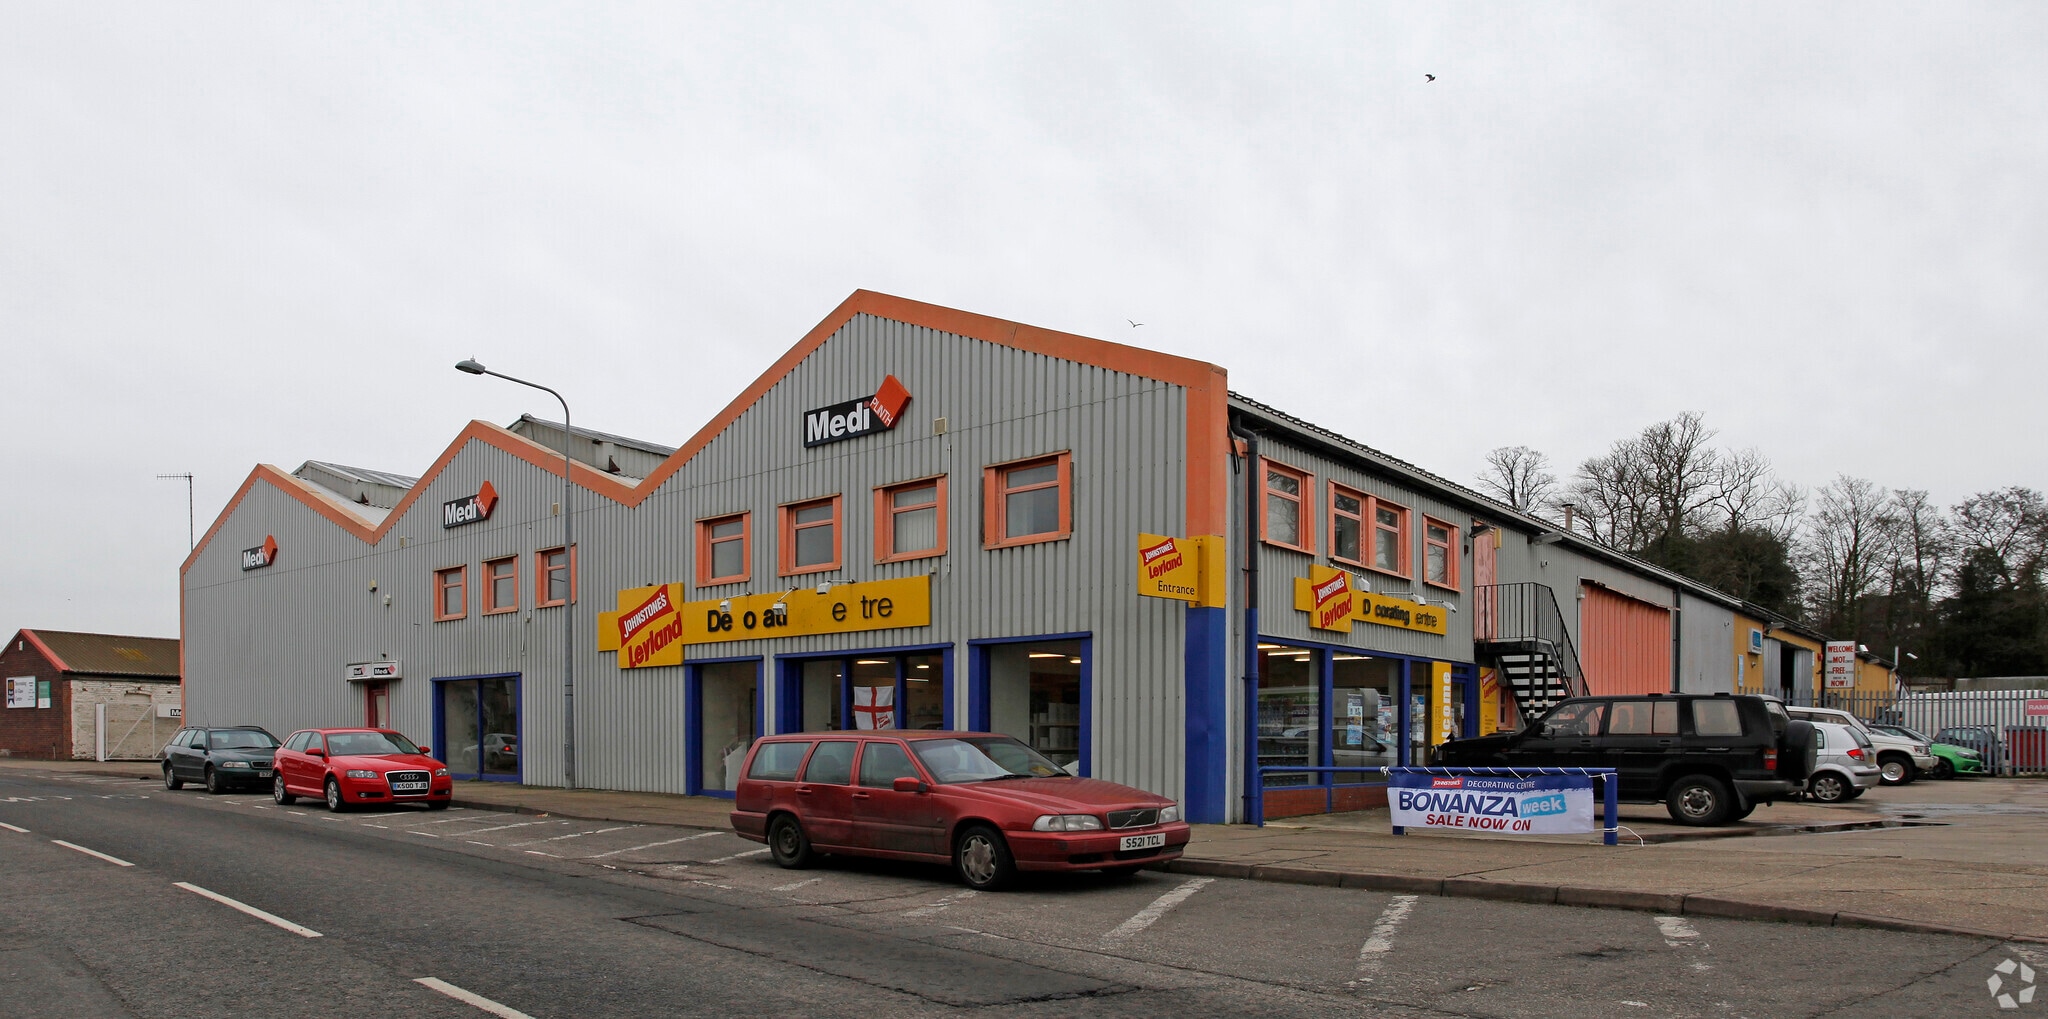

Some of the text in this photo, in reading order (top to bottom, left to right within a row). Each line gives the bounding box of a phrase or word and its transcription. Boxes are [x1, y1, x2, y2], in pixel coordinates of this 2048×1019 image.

[807, 401, 870, 443] Medi
[870, 397, 893, 427] PLINTH
[445, 499, 477, 525] Medi
[243, 548, 264, 568] Medi
[1148, 552, 1183, 580] Leyland
[1158, 579, 1195, 595] Entrance
[623, 592, 668, 638] JOHNSTONE'S
[1319, 593, 1352, 628] Leyland
[627, 611, 682, 669] Leyland
[1827, 645, 1854, 653] WELCOME
[1832, 656, 1846, 664] MOT
[1832, 666, 1846, 675] FREE
[1467, 780, 1515, 790] DECORATING
[1516, 780, 1536, 790] CENTRE
[1399, 791, 1563, 818] BONANZA week
[1425, 813, 1532, 832] SALE NOW ON
[1126, 835, 1160, 848] S521 TCL
